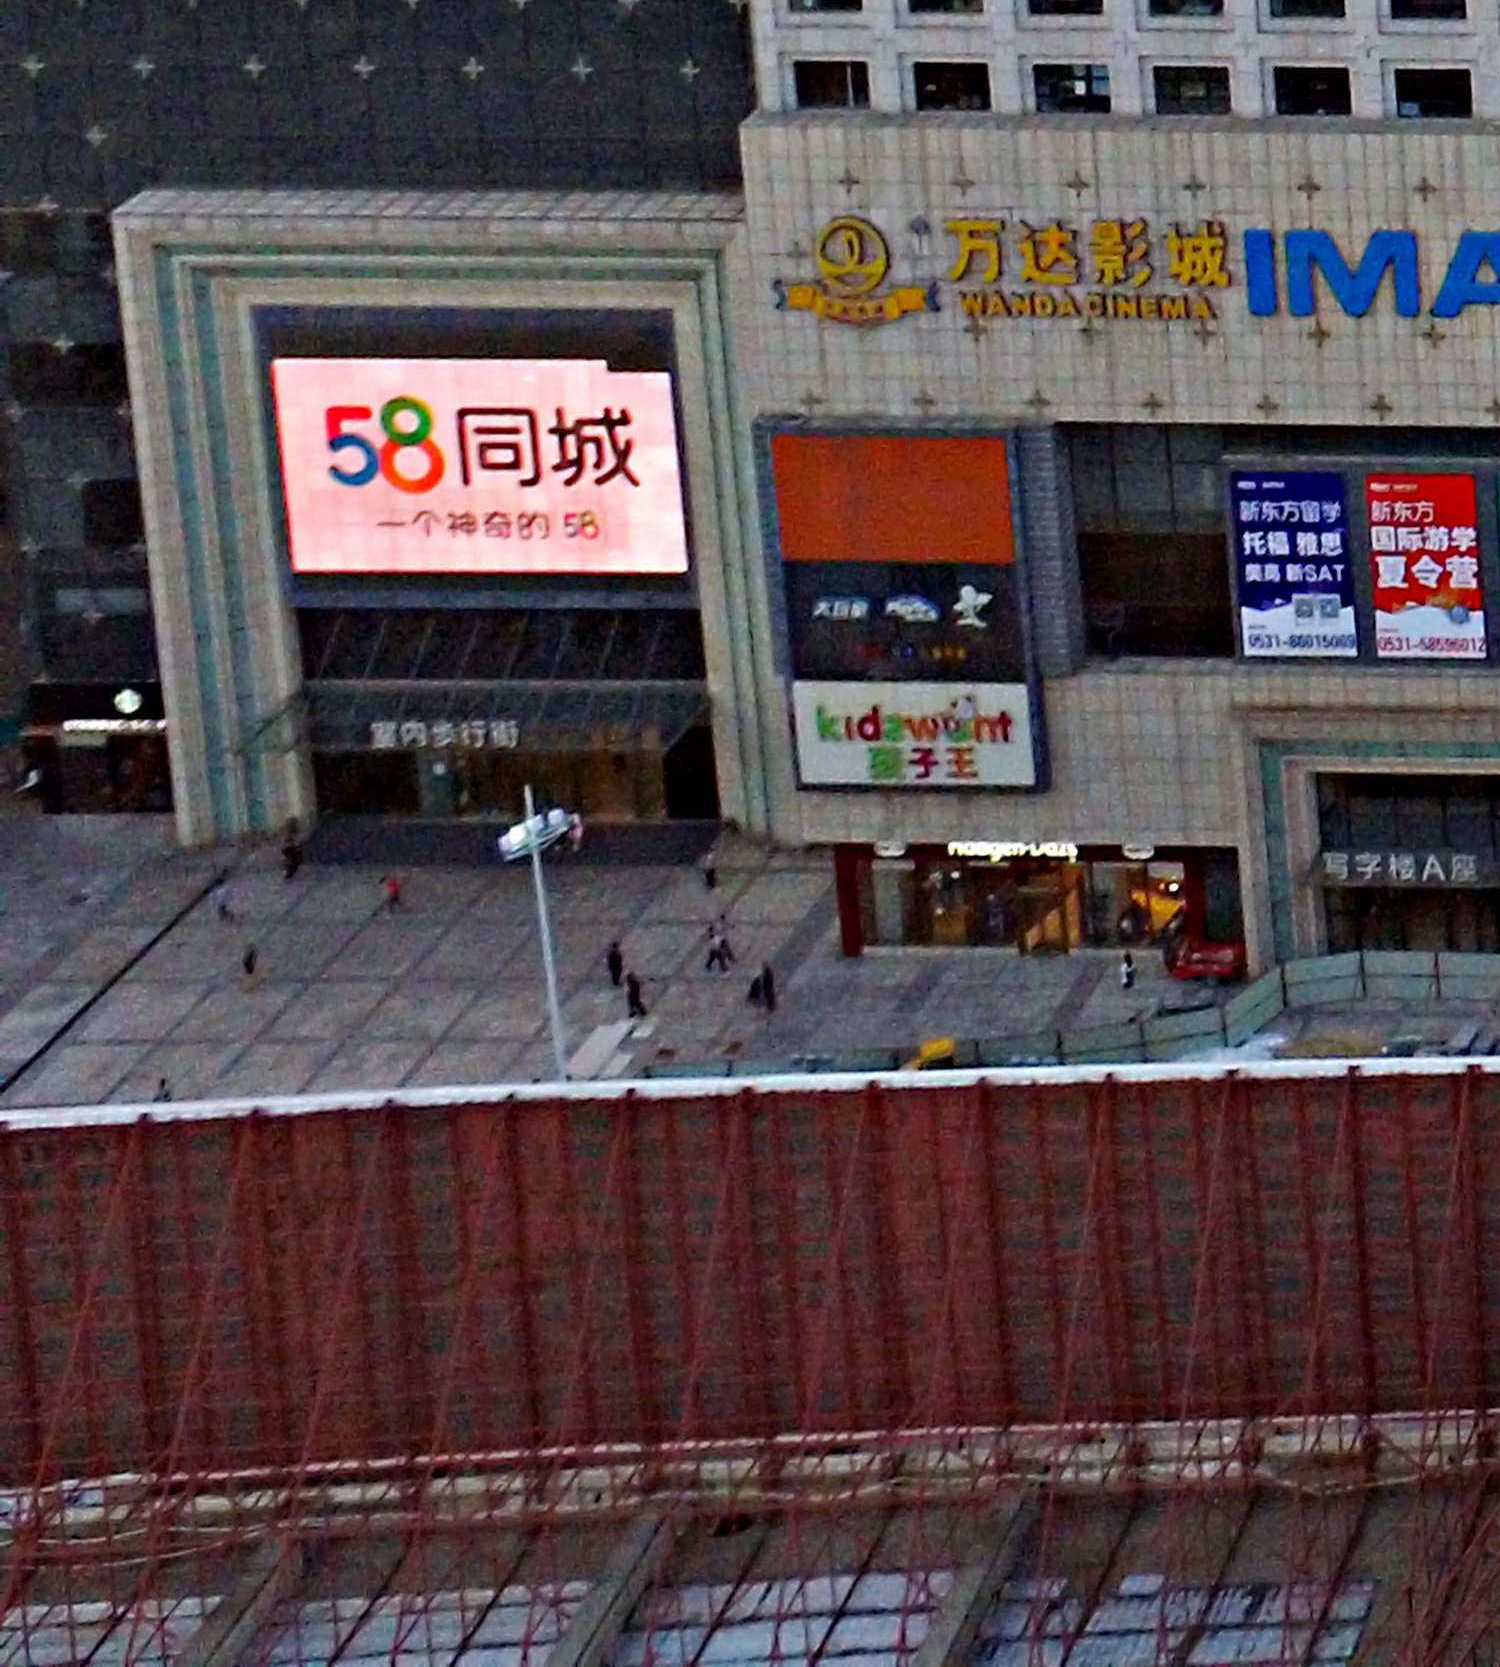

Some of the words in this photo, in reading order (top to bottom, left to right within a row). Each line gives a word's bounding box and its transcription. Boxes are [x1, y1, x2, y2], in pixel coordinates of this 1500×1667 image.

[945, 216, 1231, 288] 万达影城
[958, 290, 1082, 318] WANDA
[1084, 291, 1219, 320] CINEMA
[377, 509, 550, 539] 一个神奇的
[563, 509, 600, 539] 58
[1239, 500, 1341, 523] 新东方留学
[1371, 500, 1434, 524] 新东方
[1242, 531, 1290, 556] 托福
[1296, 531, 1343, 556] 雅思
[1370, 525, 1477, 552] 国际游学
[1285, 563, 1345, 584] 新SAT
[1377, 555, 1479, 588] 夏令营
[370, 720, 520, 749] 室内步行街
[1322, 851, 1478, 882] 写字楼A座
